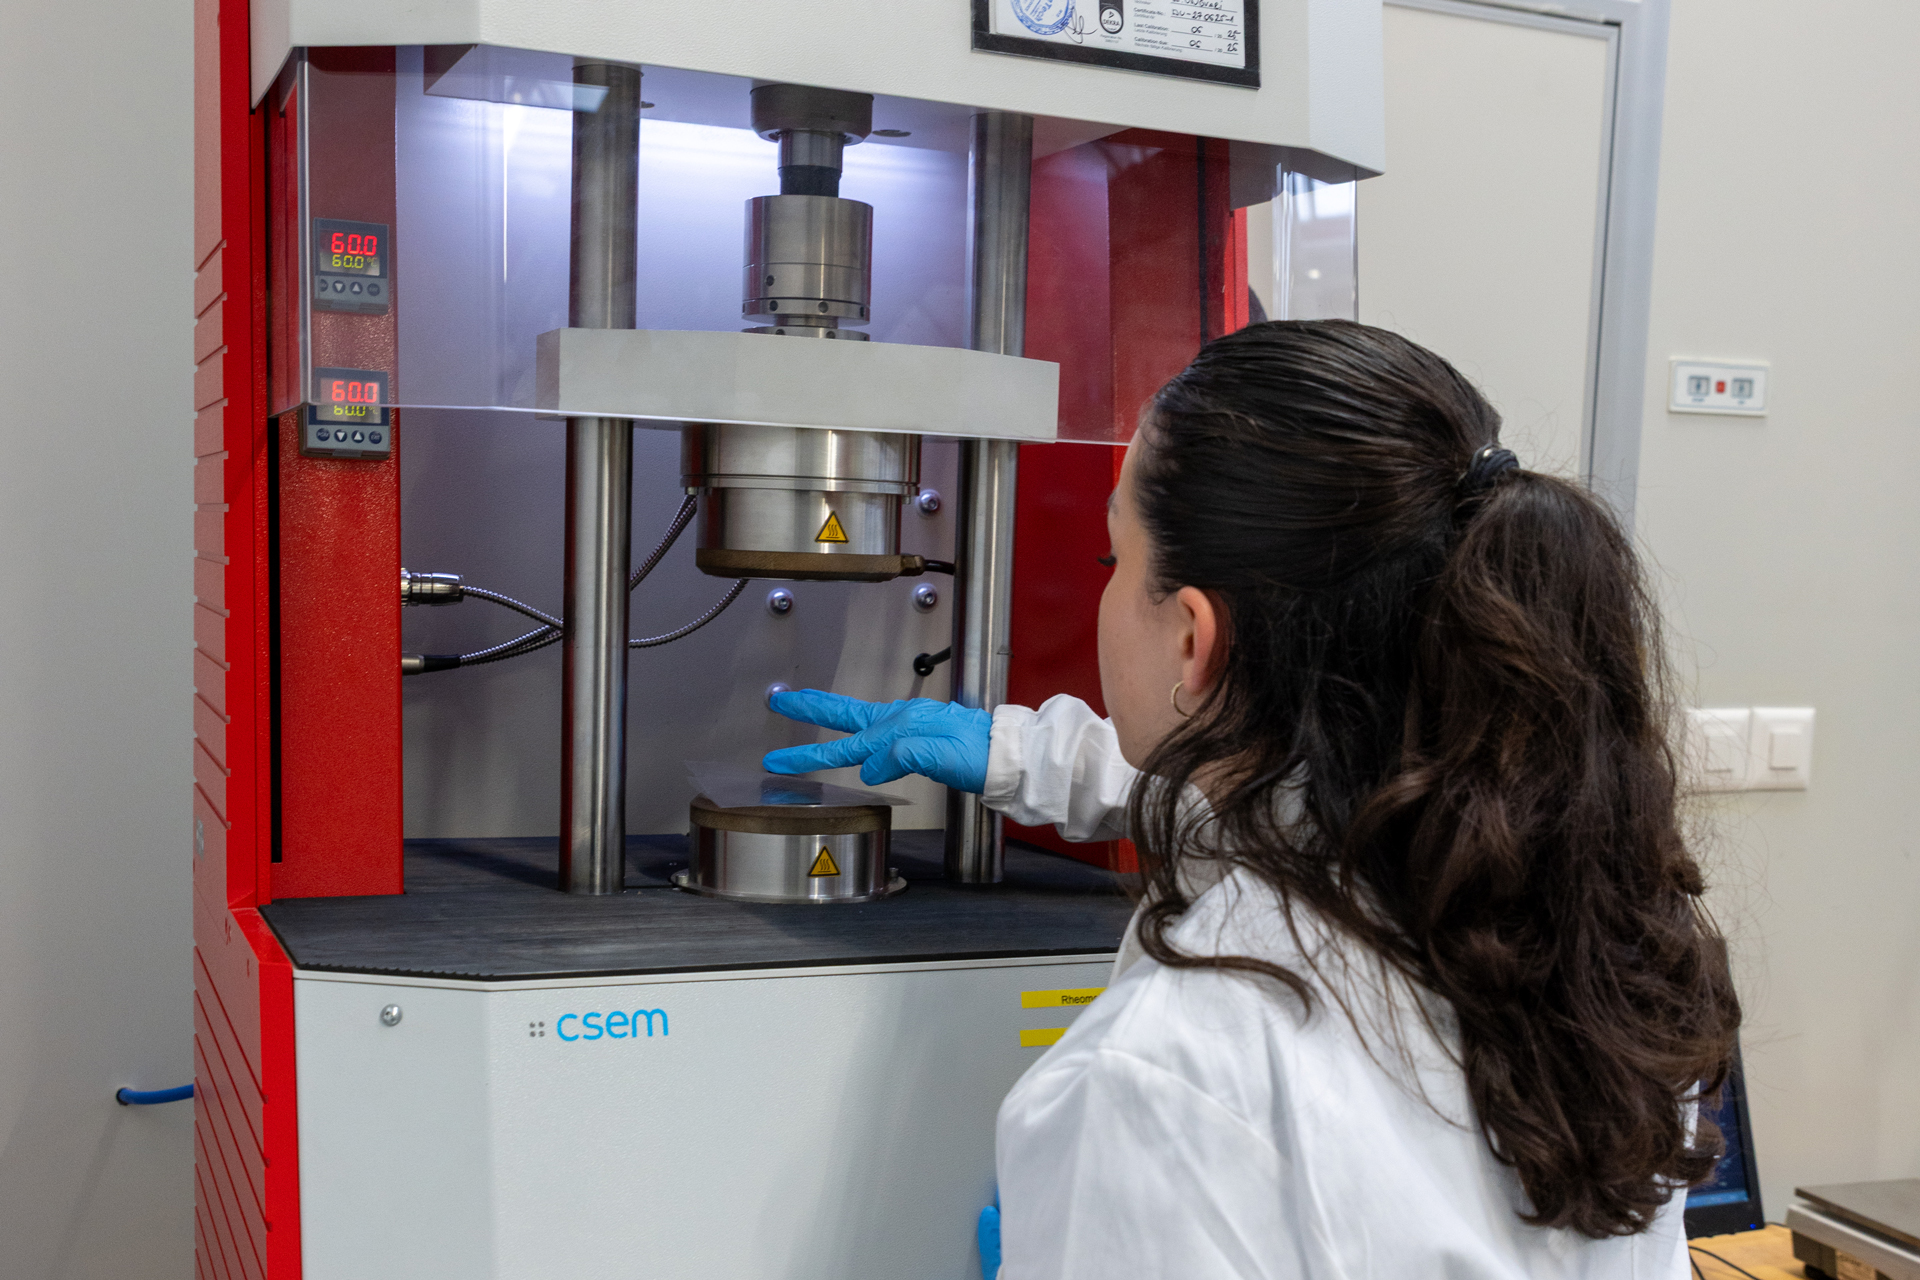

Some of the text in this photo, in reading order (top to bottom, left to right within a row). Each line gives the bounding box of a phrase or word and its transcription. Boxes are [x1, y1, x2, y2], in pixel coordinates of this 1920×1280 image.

[331, 232, 378, 256] 60.0
[332, 254, 364, 269] 60.0
[331, 380, 378, 403] 60.0
[557, 1008, 669, 1042] csem
